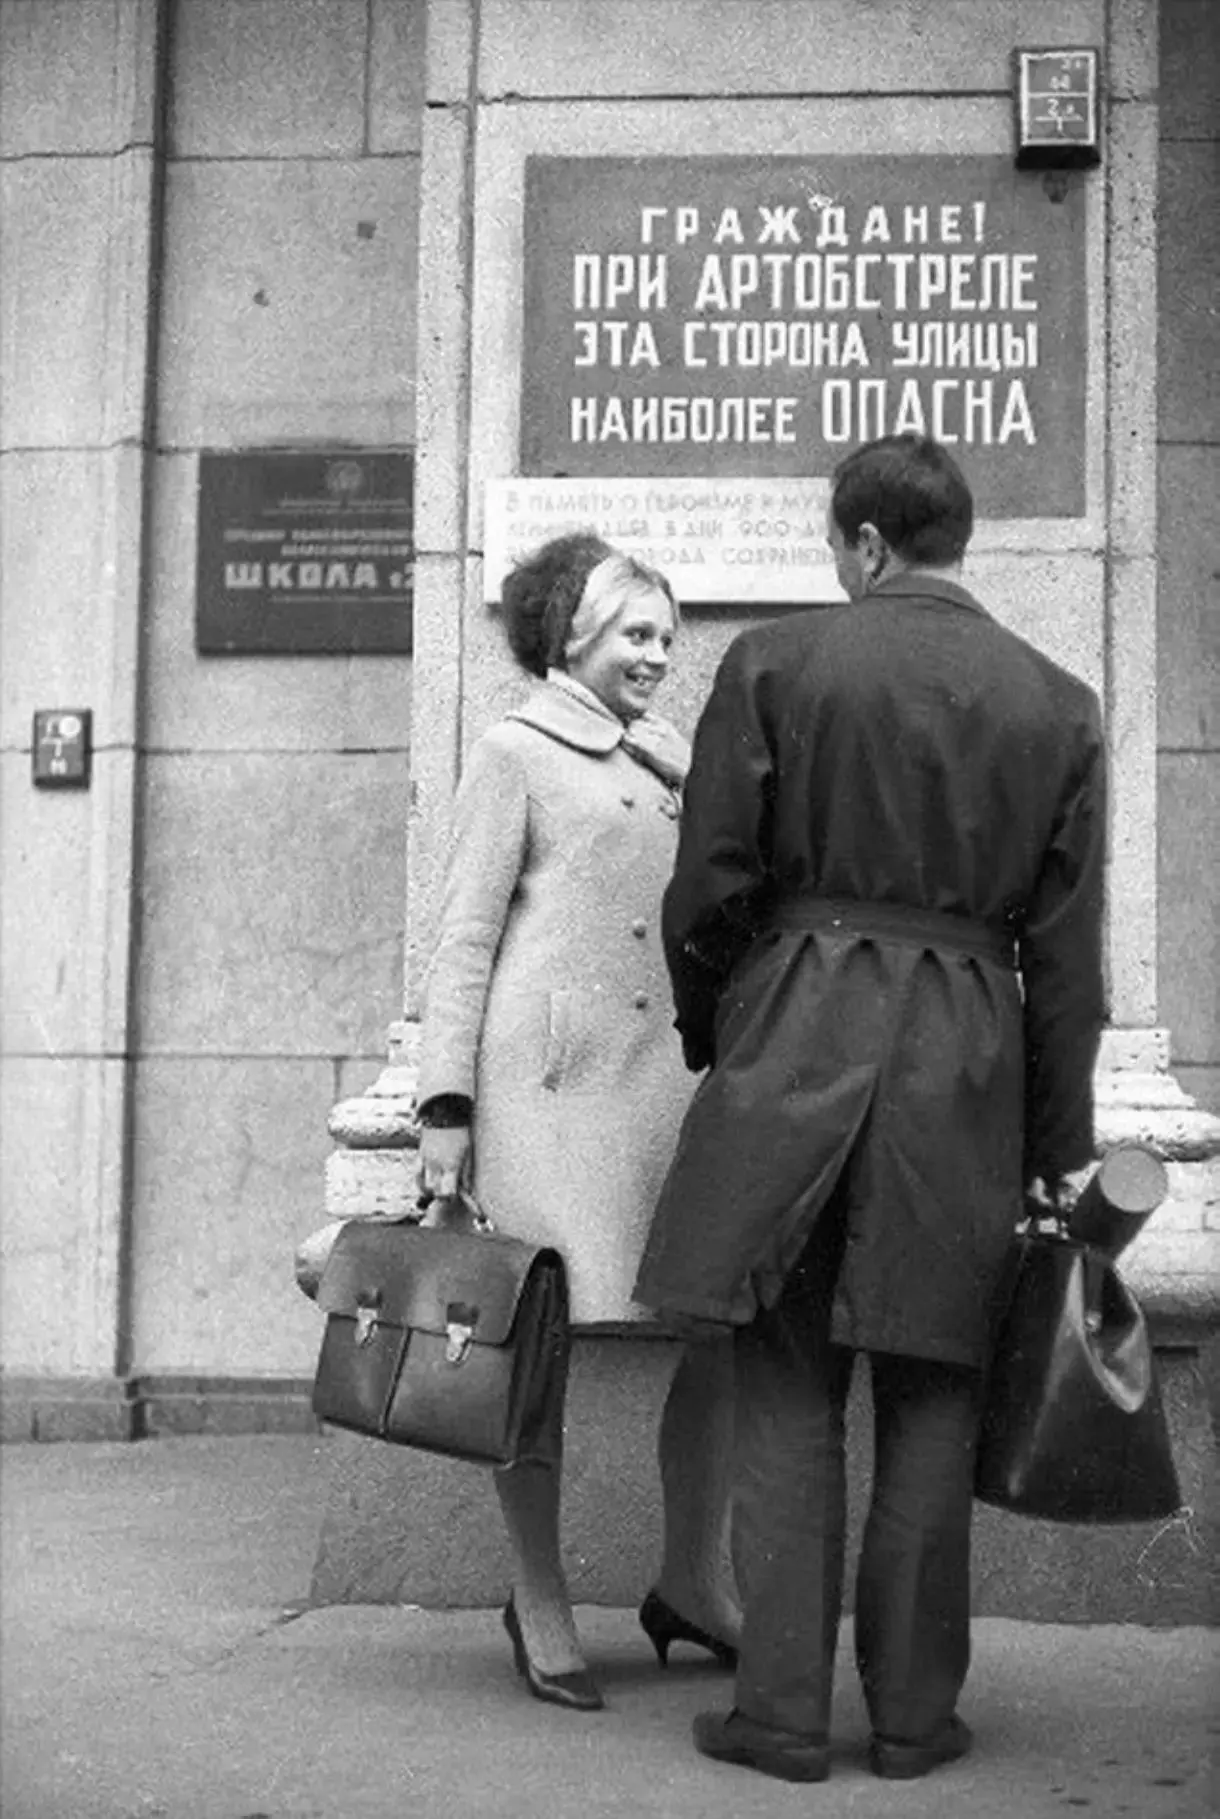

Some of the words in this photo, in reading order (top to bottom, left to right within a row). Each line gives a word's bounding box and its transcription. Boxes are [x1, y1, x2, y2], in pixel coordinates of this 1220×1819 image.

[641, 201, 985, 248] ГРАЖДАНЕ!
[573, 253, 667, 311] ПРИ
[694, 253, 1038, 311] АРТОБСТРЕЛЕ
[574, 321, 661, 368] ЭТА
[683, 321, 870, 368] СТОРОНА
[892, 321, 1038, 372] УЛИЦЫ
[571, 396, 797, 444] НАИБОЛЕЕ
[822, 378, 1037, 446] ОПАСНА
[223, 561, 379, 590] ШКОЛА
